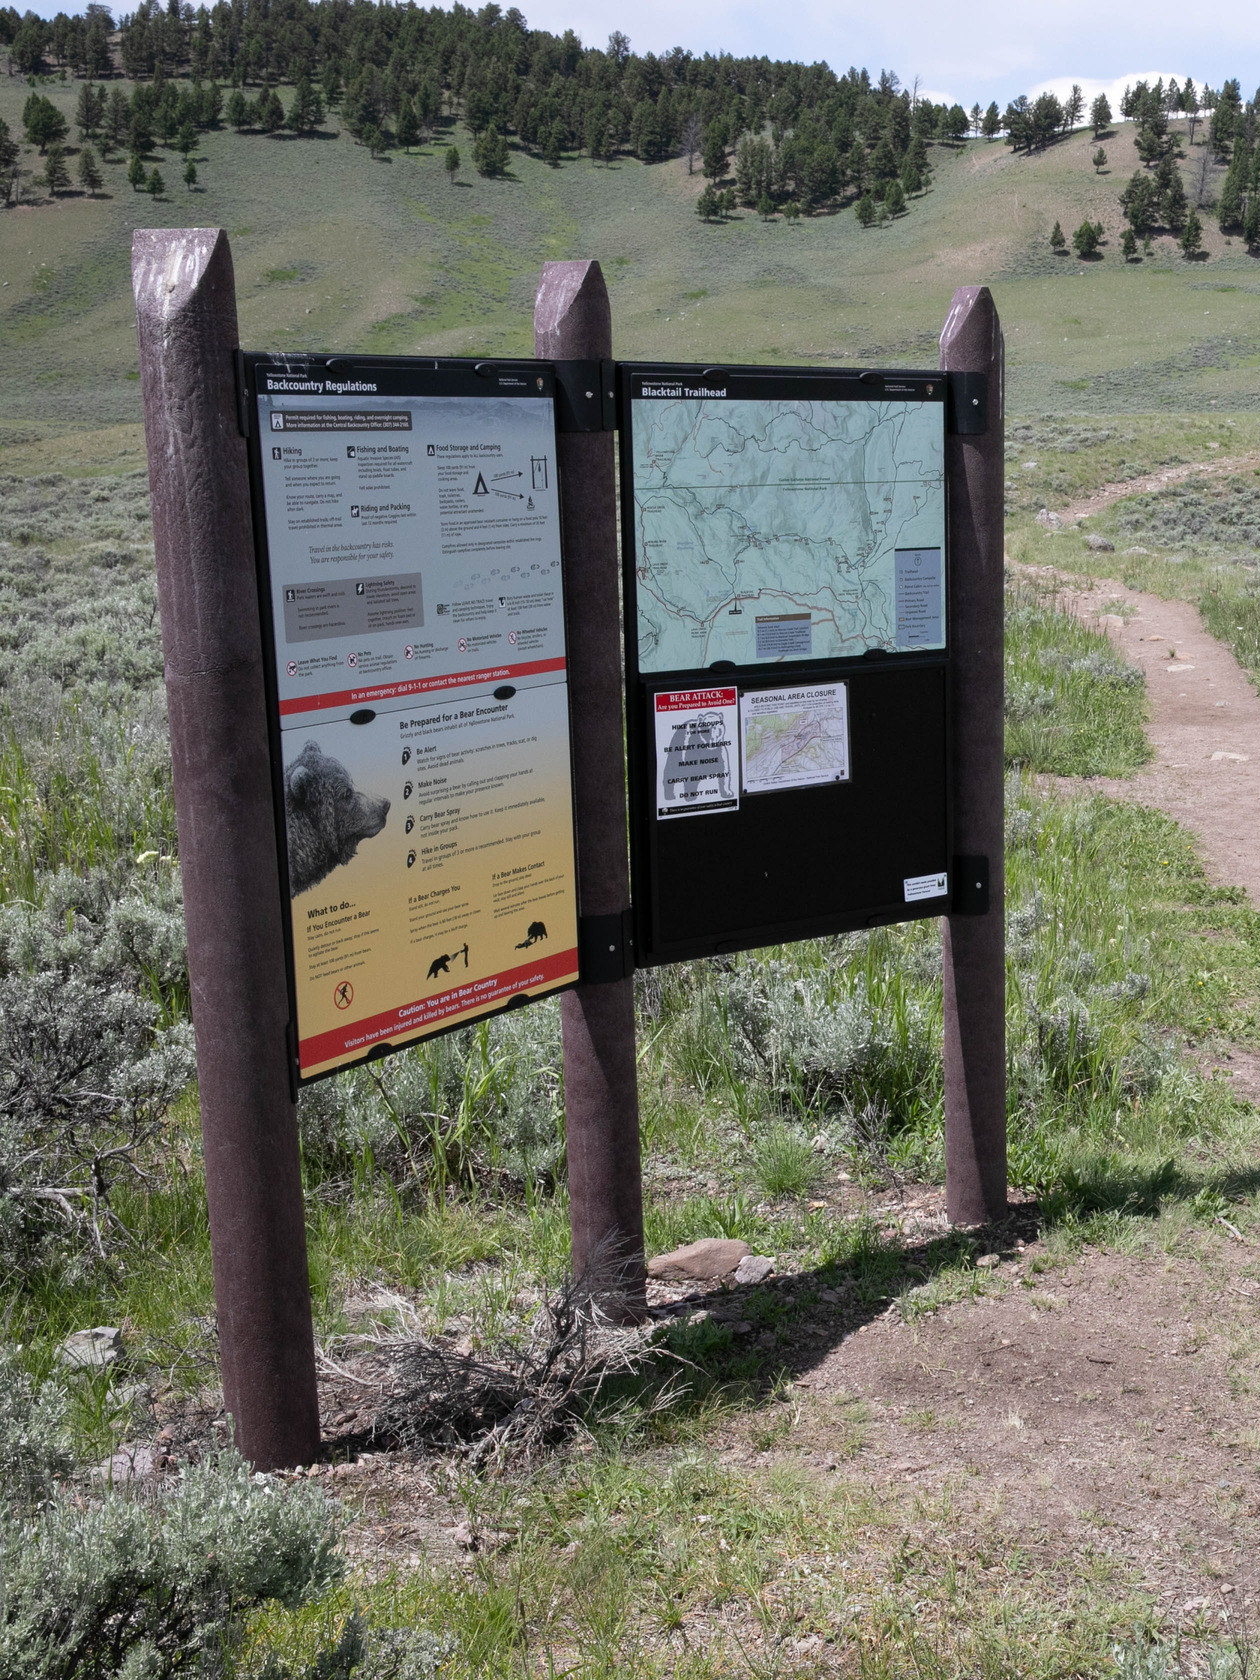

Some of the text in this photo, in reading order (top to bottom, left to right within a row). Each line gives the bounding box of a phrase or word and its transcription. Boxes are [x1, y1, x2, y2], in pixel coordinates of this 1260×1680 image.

[267, 380, 378, 393] Backcountry Regulations
[642, 387, 727, 397] Blacktail Trailhead
[283, 447, 302, 456] Hiking
[357, 446, 376, 455] Fishing
[388, 445, 409, 454] Boating
[450, 444, 469, 452] Storage
[480, 443, 501, 451] Camping
[361, 503, 410, 513] Riding and Packing
[308, 545, 325, 554] Travel
[326, 544, 331, 552] in
[332, 544, 340, 552] the
[340, 542, 371, 551] backcountry
[372, 541, 381, 549] has
[310, 555, 320, 564] You
[330, 553, 358, 564] responsible
[358, 553, 366, 562] for
[367, 553, 379, 561] your
[366, 688, 397, 697] emergency:
[397, 685, 407, 693] dial
[408, 683, 421, 691] 9-1-1
[429, 678, 447, 688] contact
[457, 674, 475, 683] nearest
[476, 673, 492, 681] ranger
[493, 670, 510, 678] station.
[670, 691, 723, 702] BEAR ATTACK:
[679, 699, 701, 708] Prepared
[708, 697, 721, 705] Avoid
[751, 688, 837, 704] SEASONAL AREA CLOSURE
[400, 721, 409, 729] Be
[410, 715, 441, 727] Prepared
[442, 714, 452, 722] for
[459, 710, 474, 719] Bear
[476, 704, 508, 716] Encounter
[444, 722, 458, 731] inhabit
[468, 718, 490, 726] Yellowstone
[491, 714, 506, 722] National
[698, 719, 723, 727] GROUPS
[424, 745, 437, 754] Alert
[664, 739, 732, 753] BE ALERT FOR BEARS
[678, 756, 719, 767] MAKE NOISE
[418, 777, 447, 788] Make Noise
[667, 770, 730, 784] CARRY BEAR SPRAY
[420, 808, 460, 822] Carry Bear Spray
[421, 847, 433, 855] Hike
[440, 842, 458, 851] Groups
[501, 870, 511, 878] Bear
[512, 865, 527, 875] Makes
[528, 859, 545, 870] Contact
[418, 894, 429, 902] Bear
[430, 888, 450, 898] Charges
[451, 885, 460, 893] You
[308, 905, 328, 918] What
[329, 904, 338, 913] to
[312, 923, 324, 931] You
[324, 915, 353, 927] Encounter
[358, 910, 370, 918] Bear
[398, 1003, 425, 1018] Caution:
[427, 999, 439, 1008] You
[440, 995, 450, 1004] are
[459, 988, 473, 998] Bear
[474, 980, 498, 993] Country
[344, 1037, 365, 1049] Visitors
[366, 1032, 379, 1041] have
[380, 1027, 393, 1037] been
[394, 1019, 412, 1032] injured
[413, 1015, 423, 1025] and
[424, 1010, 437, 1021] killed
[438, 1009, 445, 1017] by
[461, 999, 475, 1008] There
[488, 986, 511, 1001] guarantee
[512, 983, 517, 991] of
[518, 980, 529, 990] your
